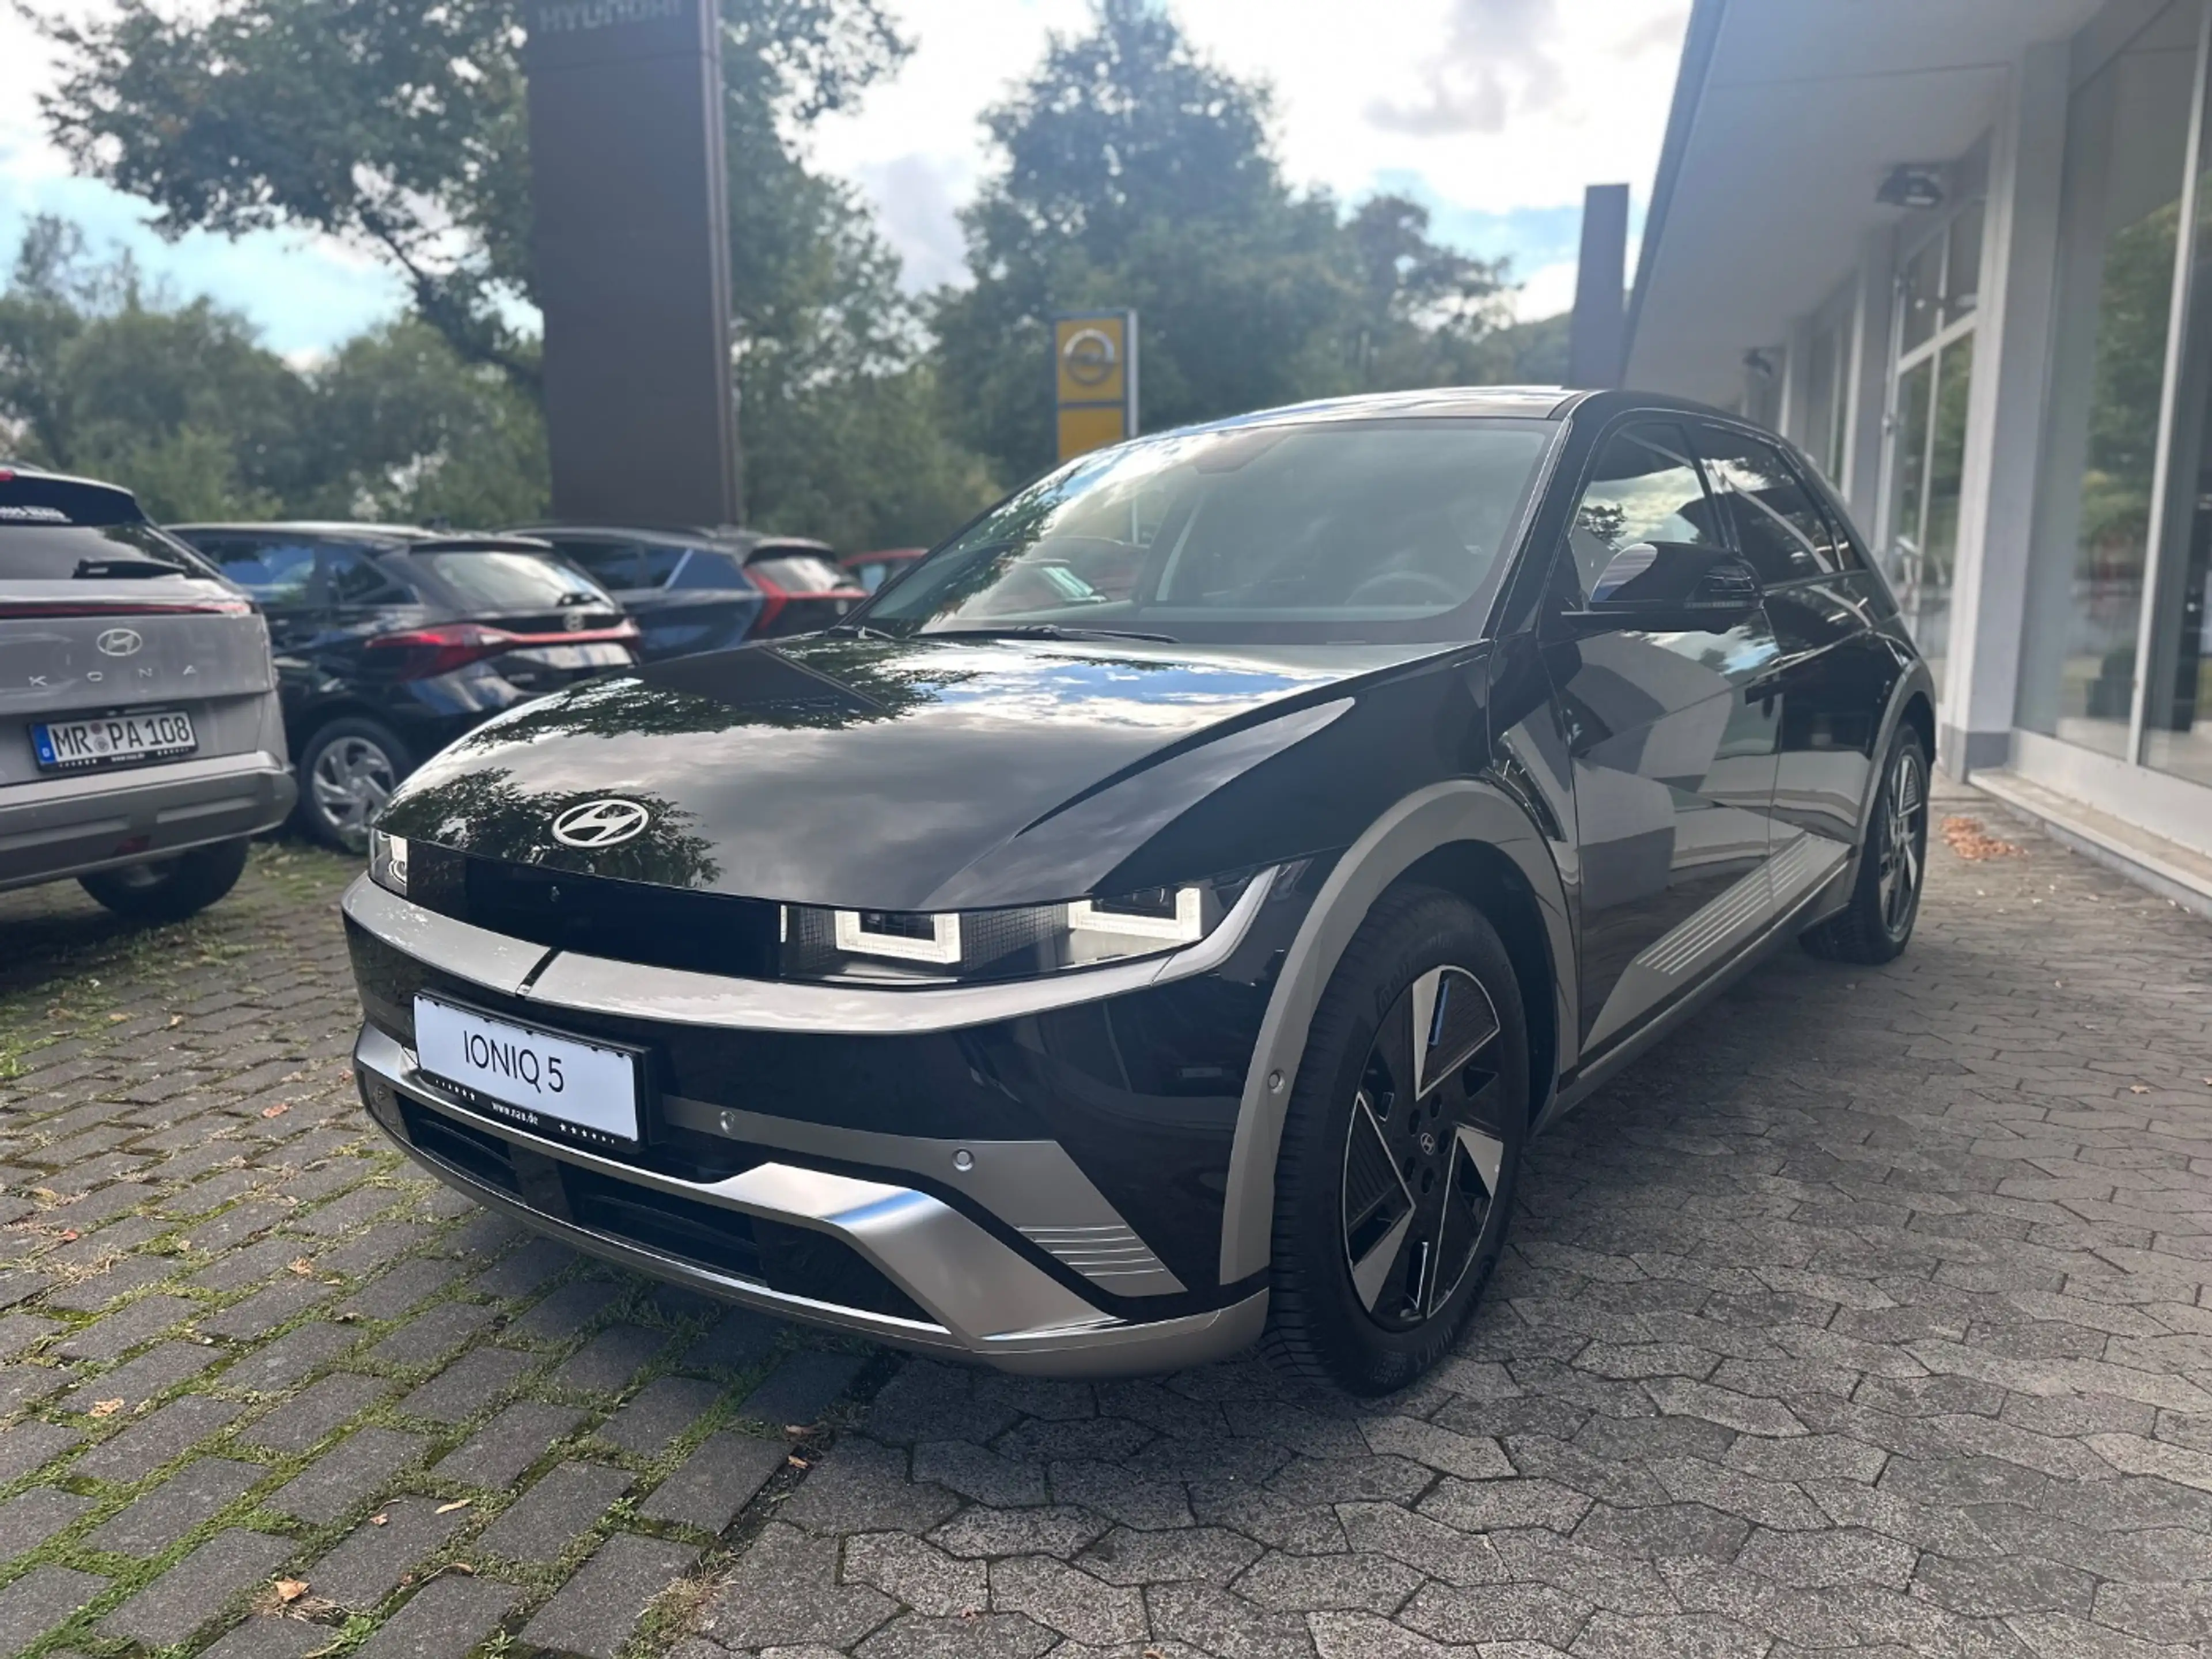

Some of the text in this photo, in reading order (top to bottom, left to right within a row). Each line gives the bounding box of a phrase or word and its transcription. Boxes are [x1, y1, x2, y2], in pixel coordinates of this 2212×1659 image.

[538, 0, 682, 33] HYUNDAI
[29, 665, 197, 687] KONA
[52, 726, 93, 757] MR
[464, 1031, 564, 1093] IONIQ 5
